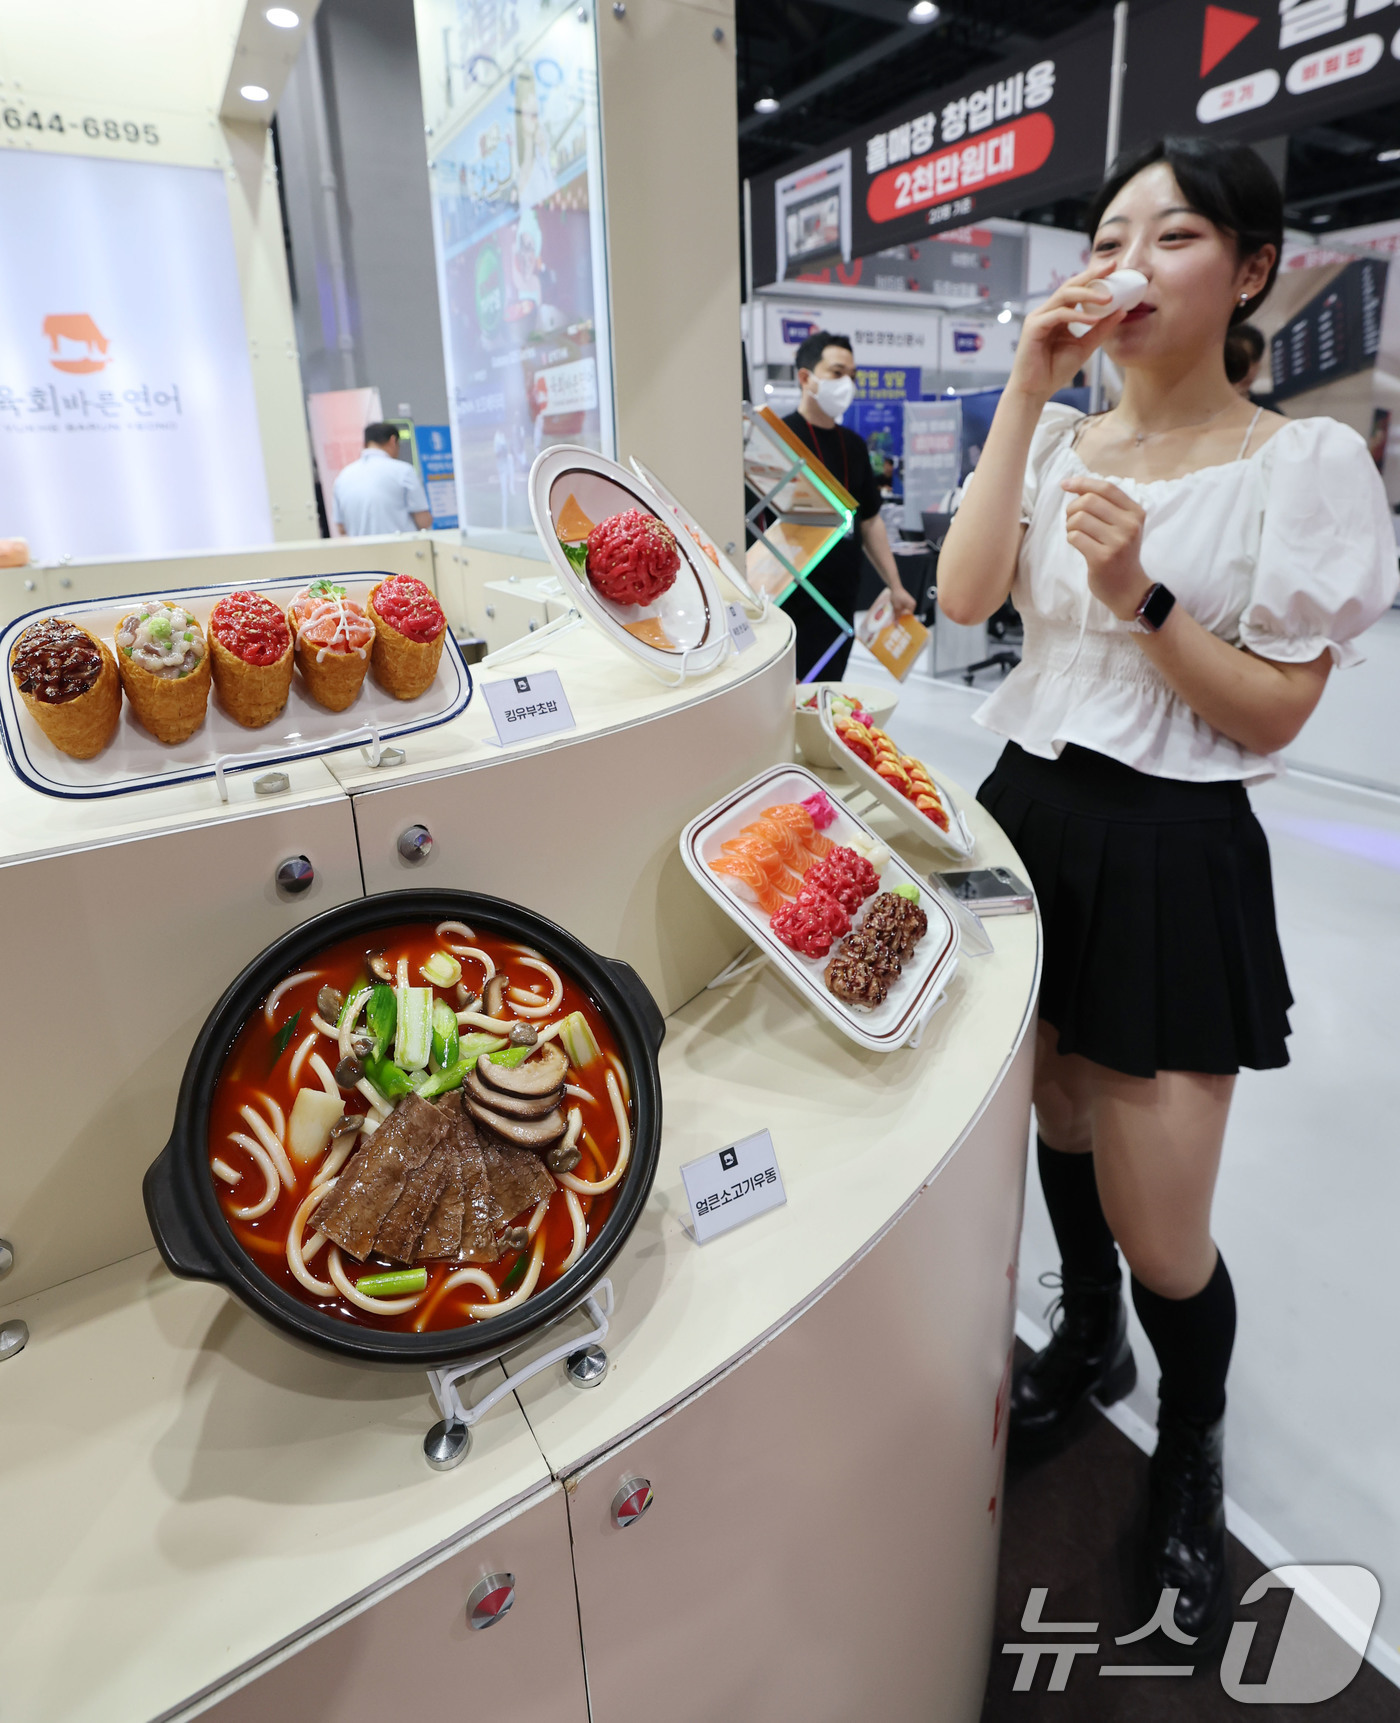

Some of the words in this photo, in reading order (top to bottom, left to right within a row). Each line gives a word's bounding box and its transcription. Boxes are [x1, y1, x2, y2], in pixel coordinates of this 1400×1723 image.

[1302, 45, 1366, 82] 비빔밥
[865, 112, 937, 174] 홀매장
[940, 60, 1056, 143] 창업비용
[894, 130, 1016, 210] 2천만원대
[504, 700, 558, 723] 킹유부초밥
[695, 1166, 777, 1217] 얼큰소고기우동
